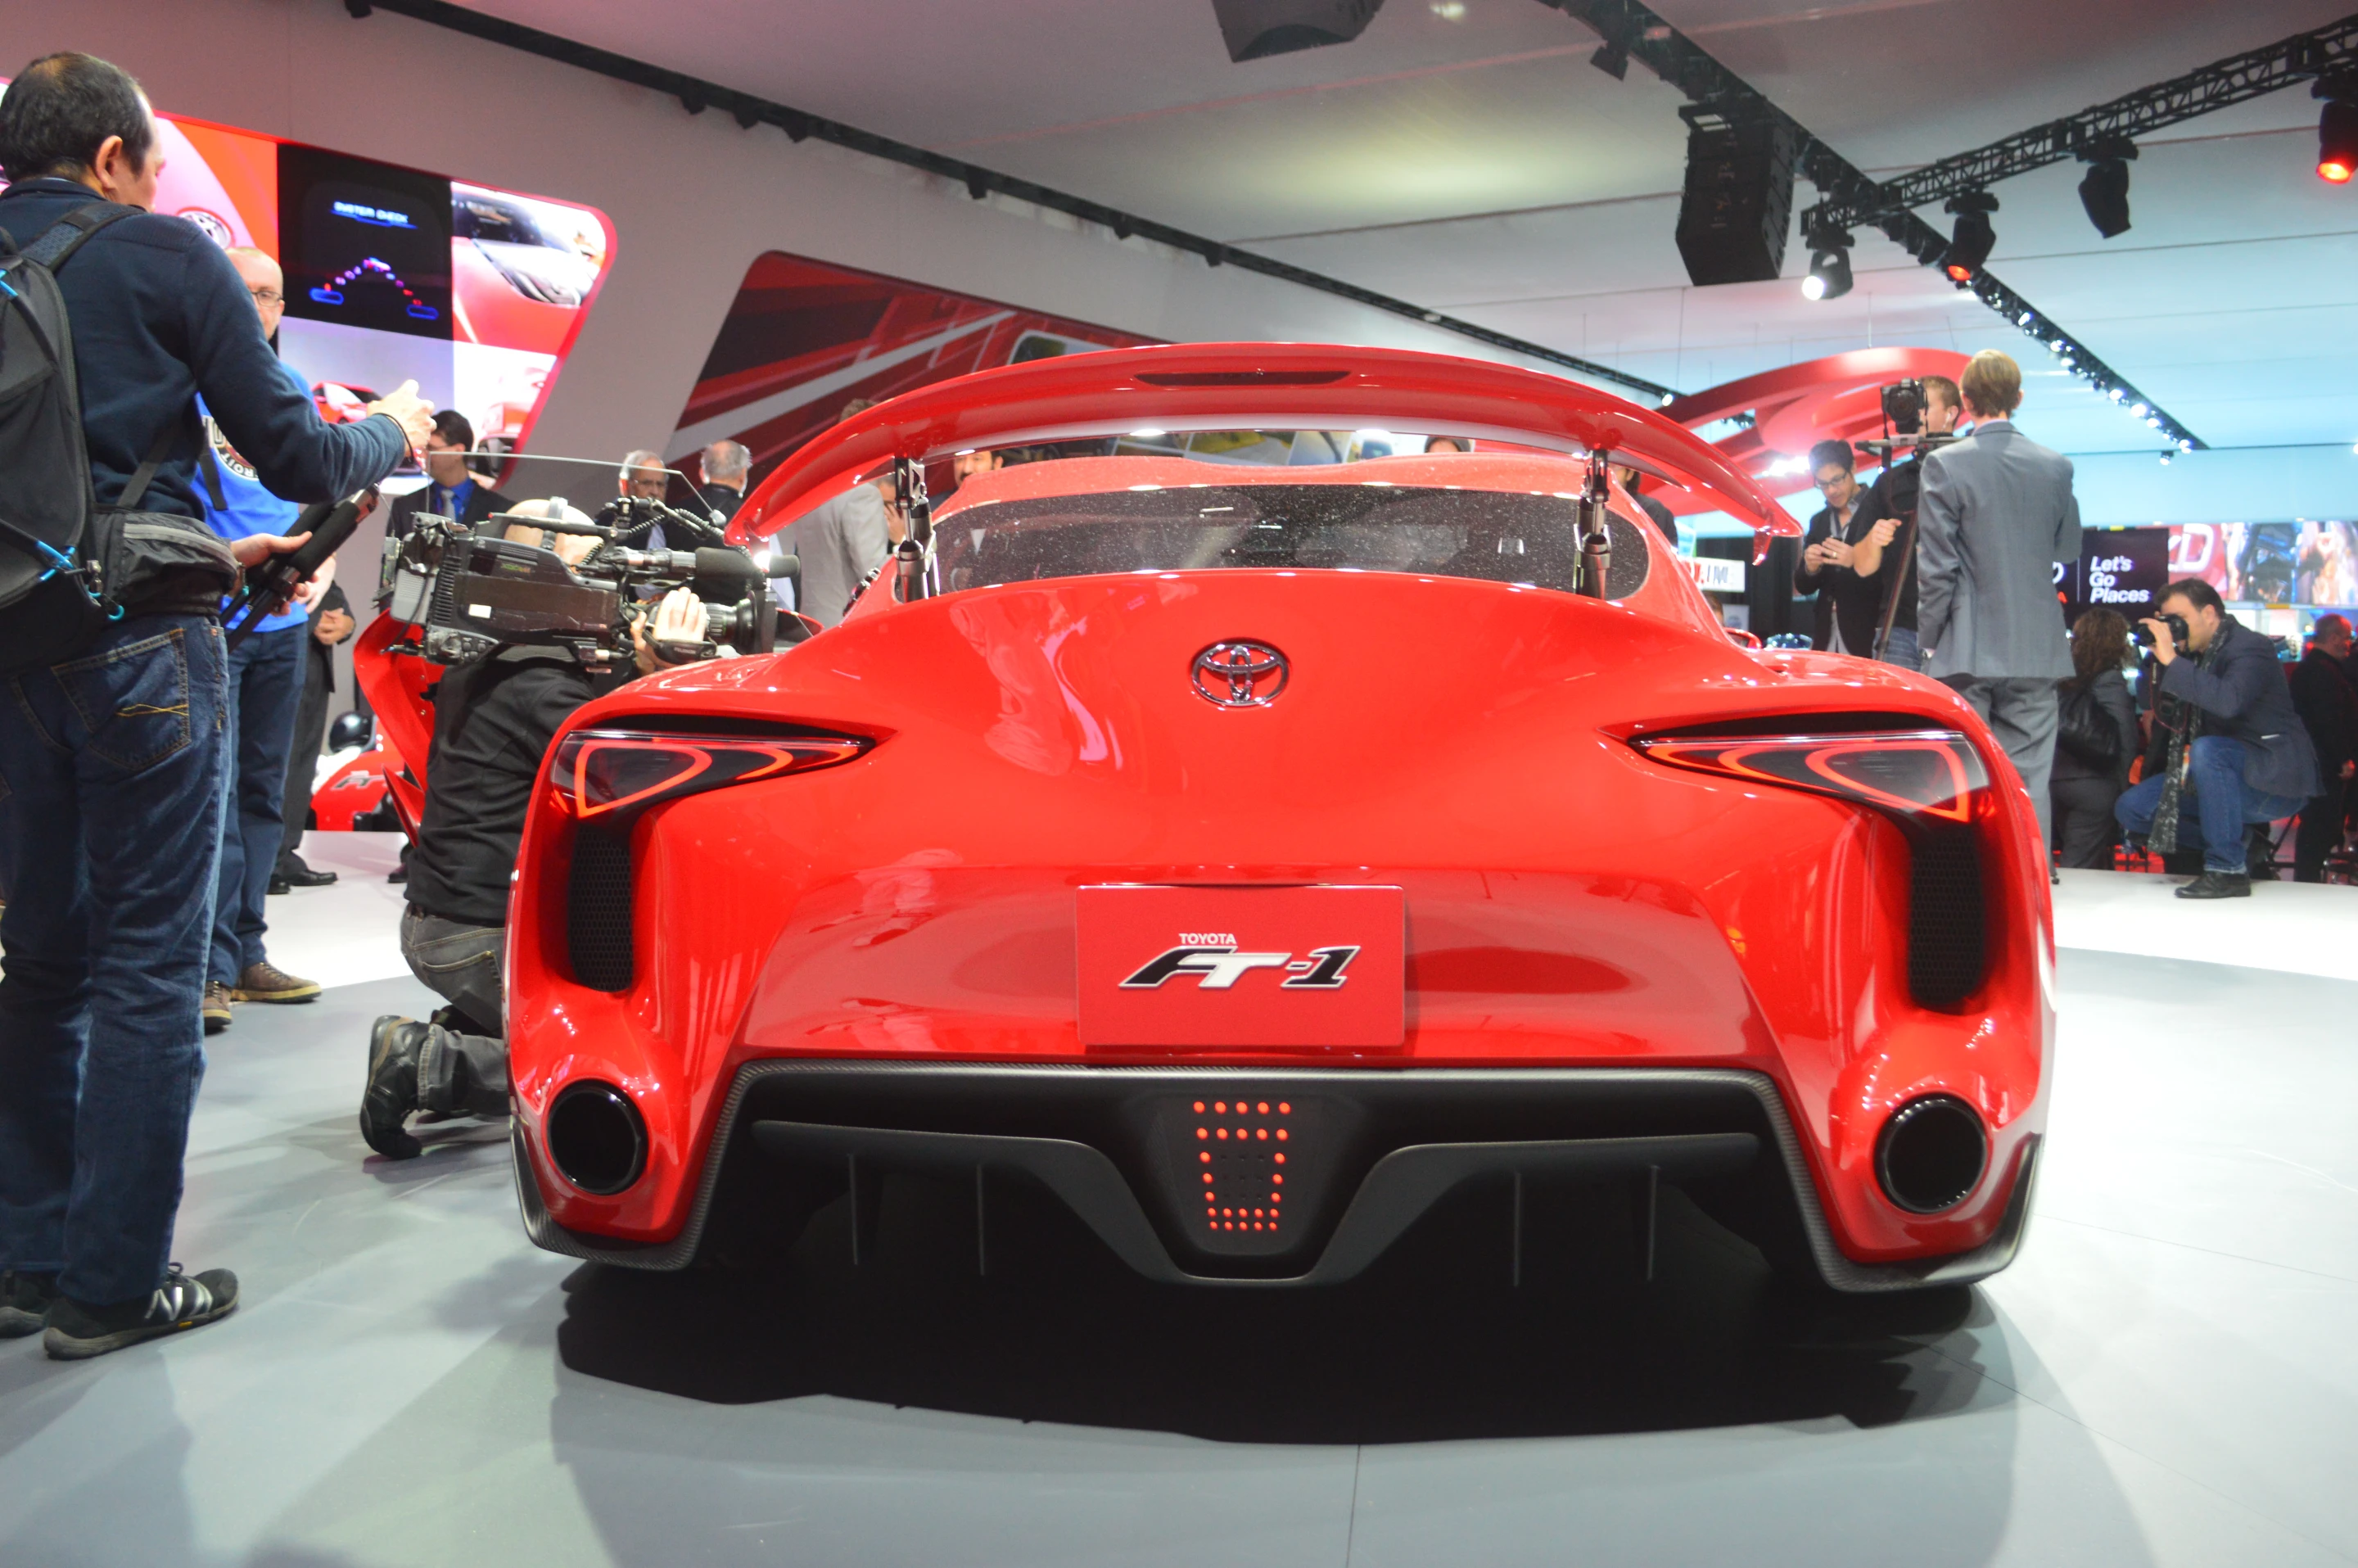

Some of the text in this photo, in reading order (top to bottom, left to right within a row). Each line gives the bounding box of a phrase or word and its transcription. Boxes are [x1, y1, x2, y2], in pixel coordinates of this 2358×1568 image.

[2089, 555, 2133, 572] Let's
[2089, 572, 2116, 587] Go
[2089, 586, 2151, 604] Places
[1178, 933, 1237, 945] TOYOTA
[1118, 945, 1362, 989] FT-1
